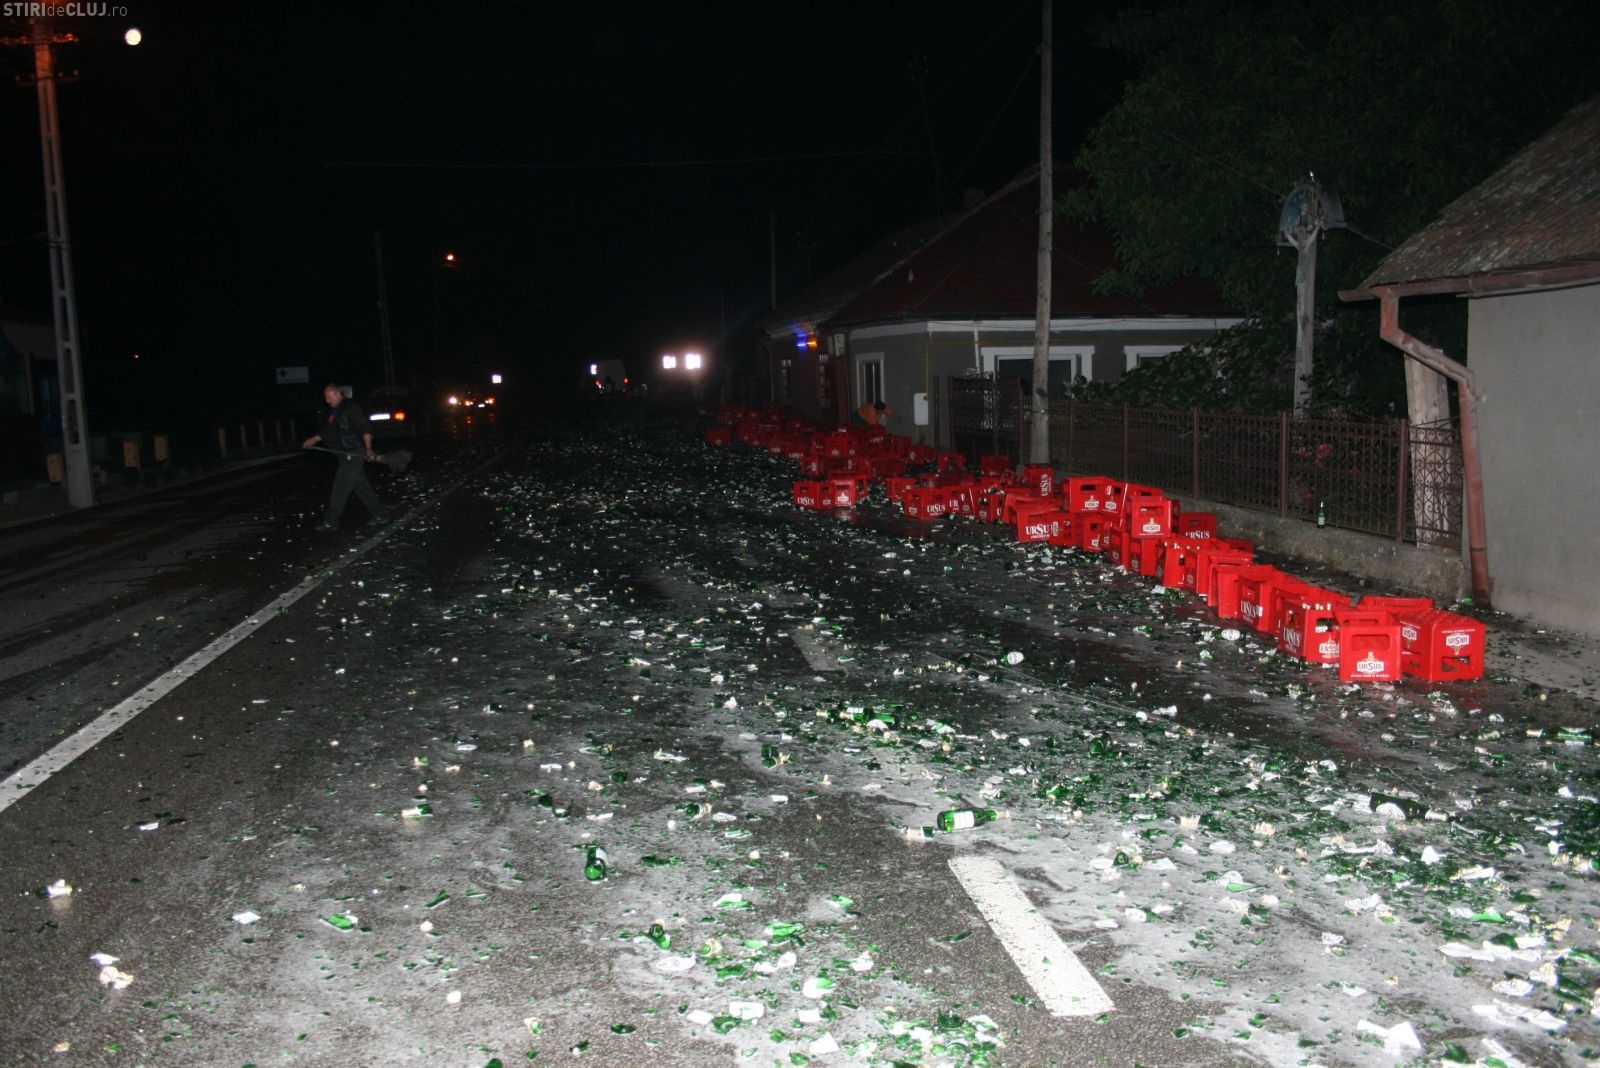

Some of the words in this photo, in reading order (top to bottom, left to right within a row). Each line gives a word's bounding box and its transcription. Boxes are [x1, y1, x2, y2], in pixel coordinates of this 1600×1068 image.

[1041, 474, 1049, 497] URSUS
[927, 503, 946, 513] URSUS
[1025, 523, 1050, 536] URSU
[1358, 662, 1382, 671] URSUS
